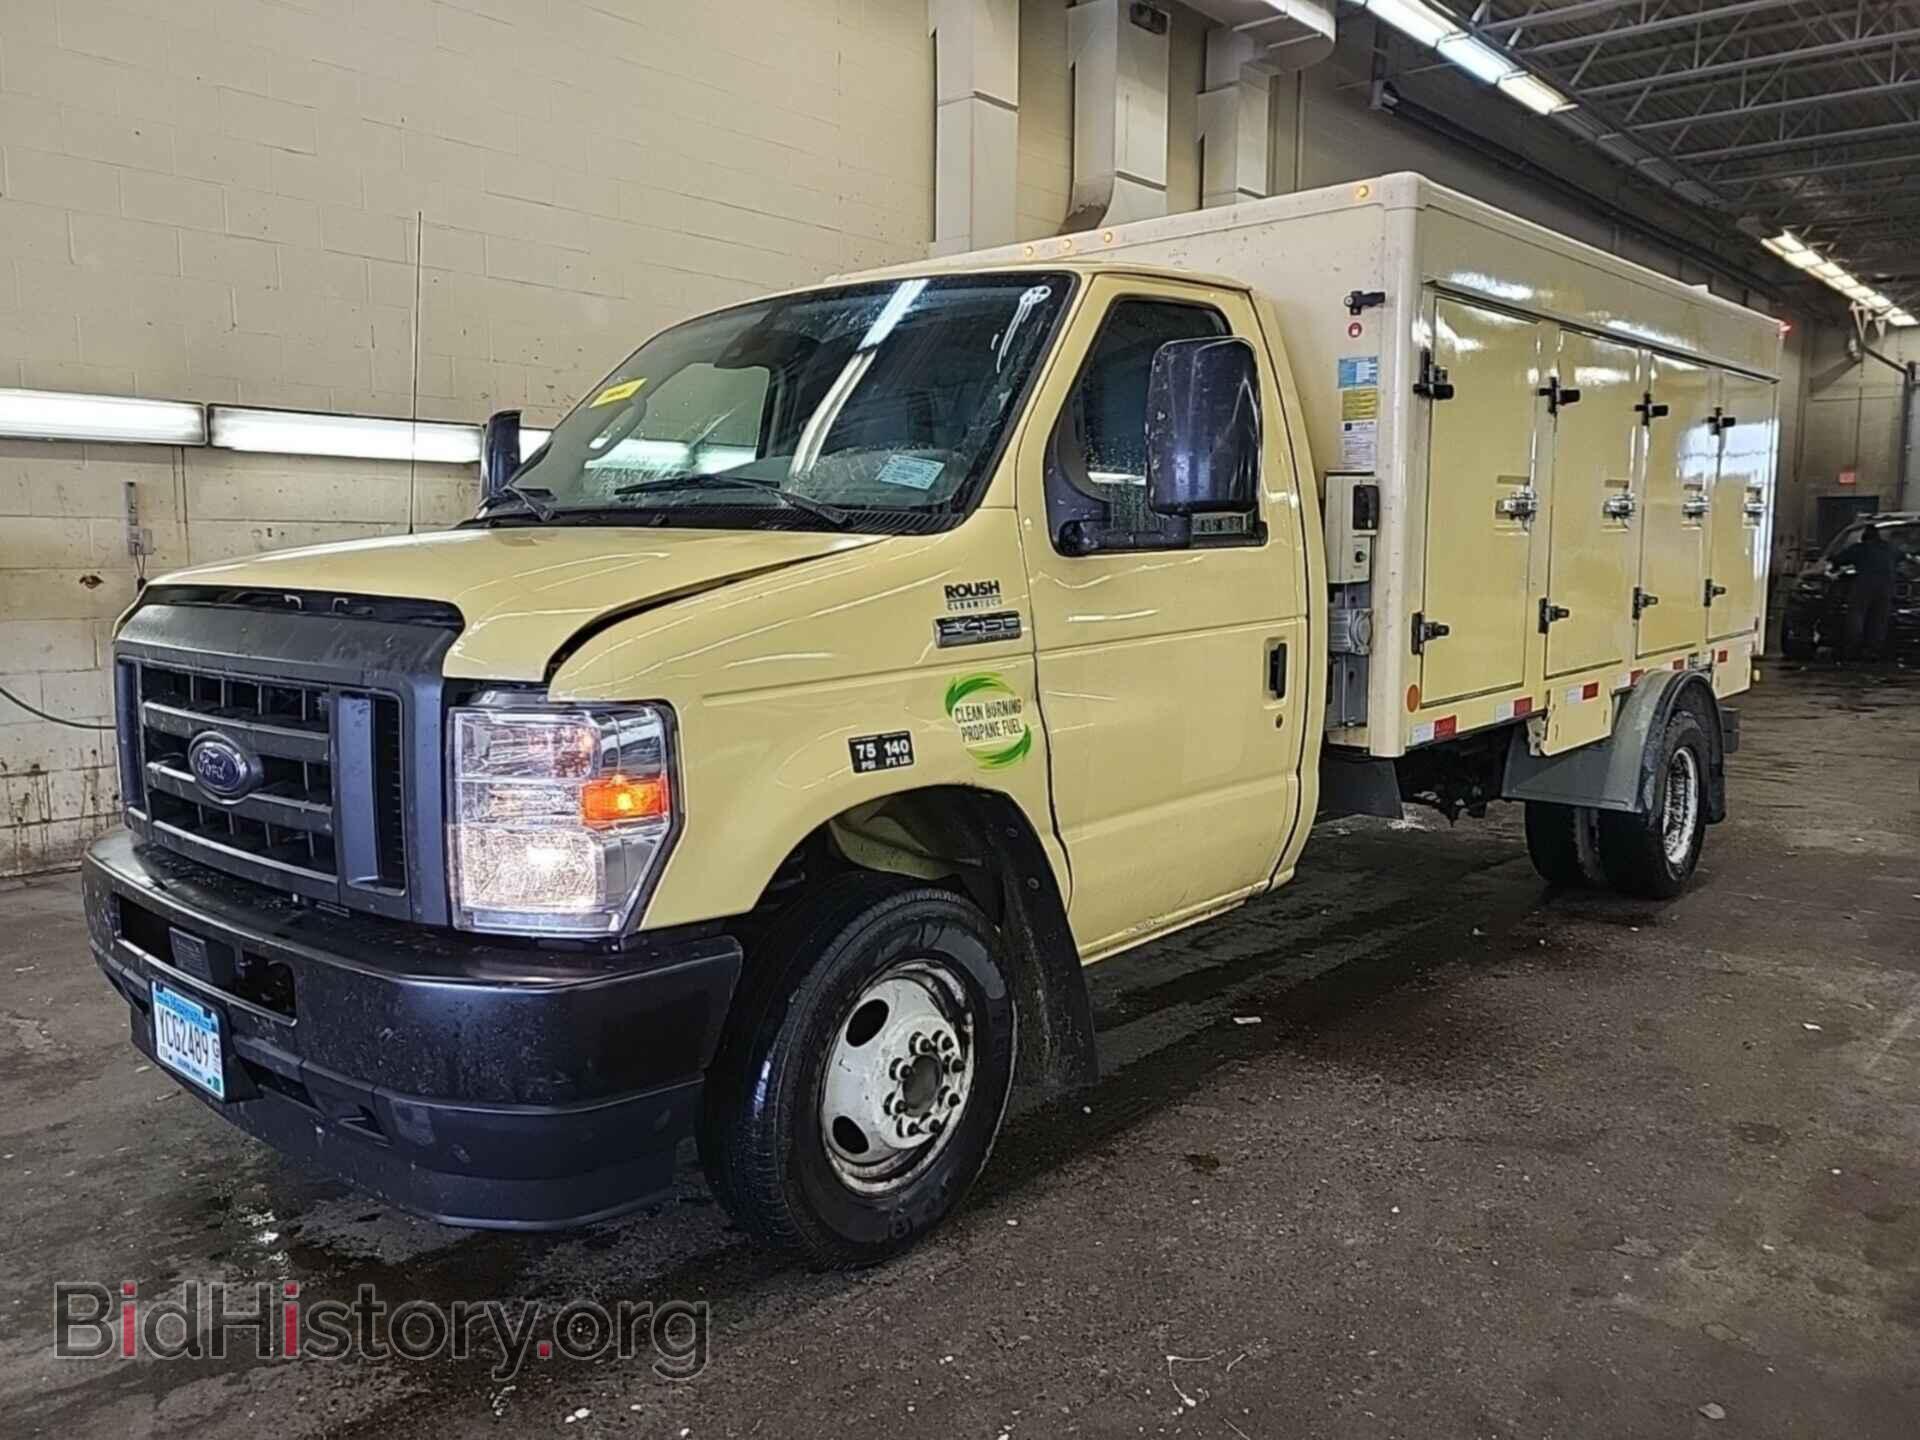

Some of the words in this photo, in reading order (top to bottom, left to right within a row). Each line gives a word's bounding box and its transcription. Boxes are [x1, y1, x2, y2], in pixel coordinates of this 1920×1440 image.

[944, 580, 1000, 599] ROUSH
[955, 705, 984, 724] CLEAN
[985, 698, 1022, 719] BURNING
[961, 721, 1002, 743] PROPANE
[1002, 718, 1024, 736] FUEL
[855, 742, 877, 760] 75
[883, 739, 910, 756] 140
[197, 749, 226, 780] Ford
[861, 760, 876, 770] PSI
